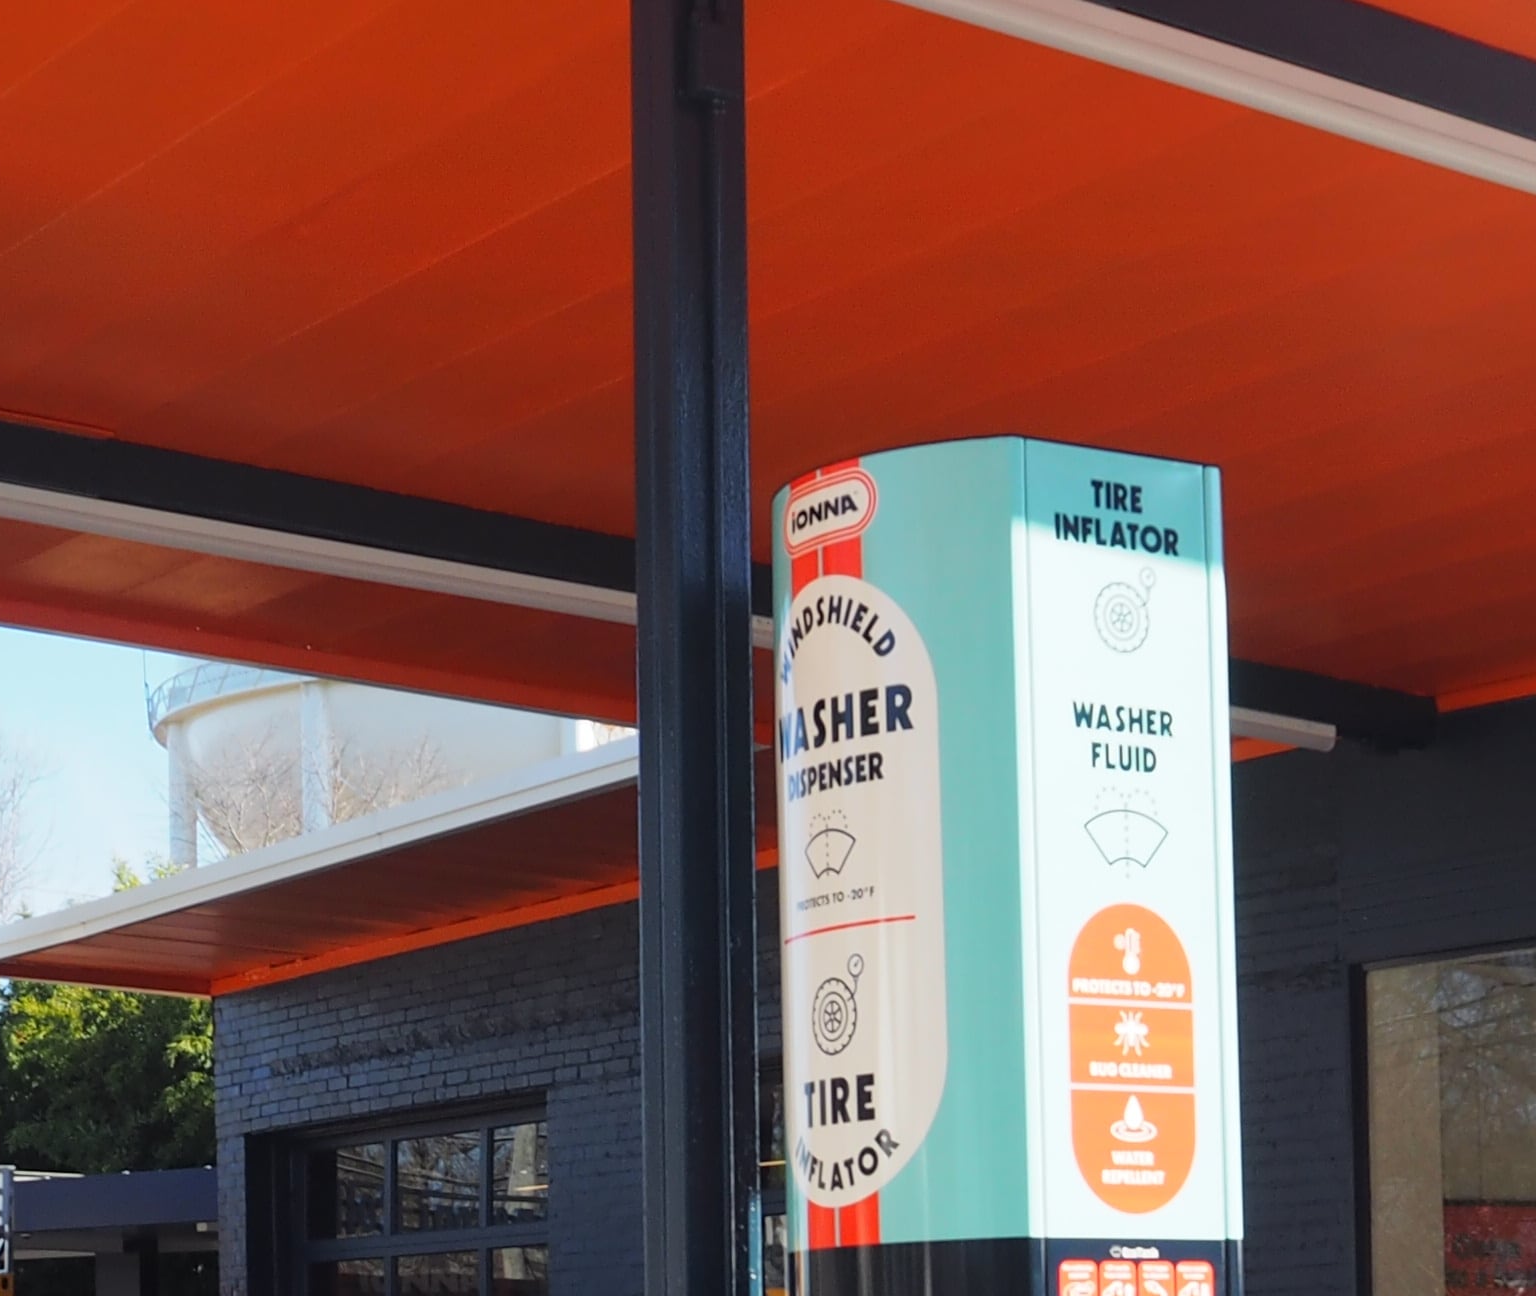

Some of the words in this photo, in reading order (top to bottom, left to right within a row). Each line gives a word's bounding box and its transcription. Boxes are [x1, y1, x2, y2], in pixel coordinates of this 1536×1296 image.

[1090, 479, 1143, 514] TIRE
[1054, 512, 1179, 557] INFLATOR
[780, 595, 896, 685] WINDSHIELD
[779, 684, 914, 763] WASHER
[1073, 700, 1173, 737] WASHER
[787, 752, 883, 801] DISPENSER
[1091, 742, 1157, 773] FLUID
[804, 1073, 876, 1128] TIRE
[796, 1128, 900, 1191] INFLATOR
